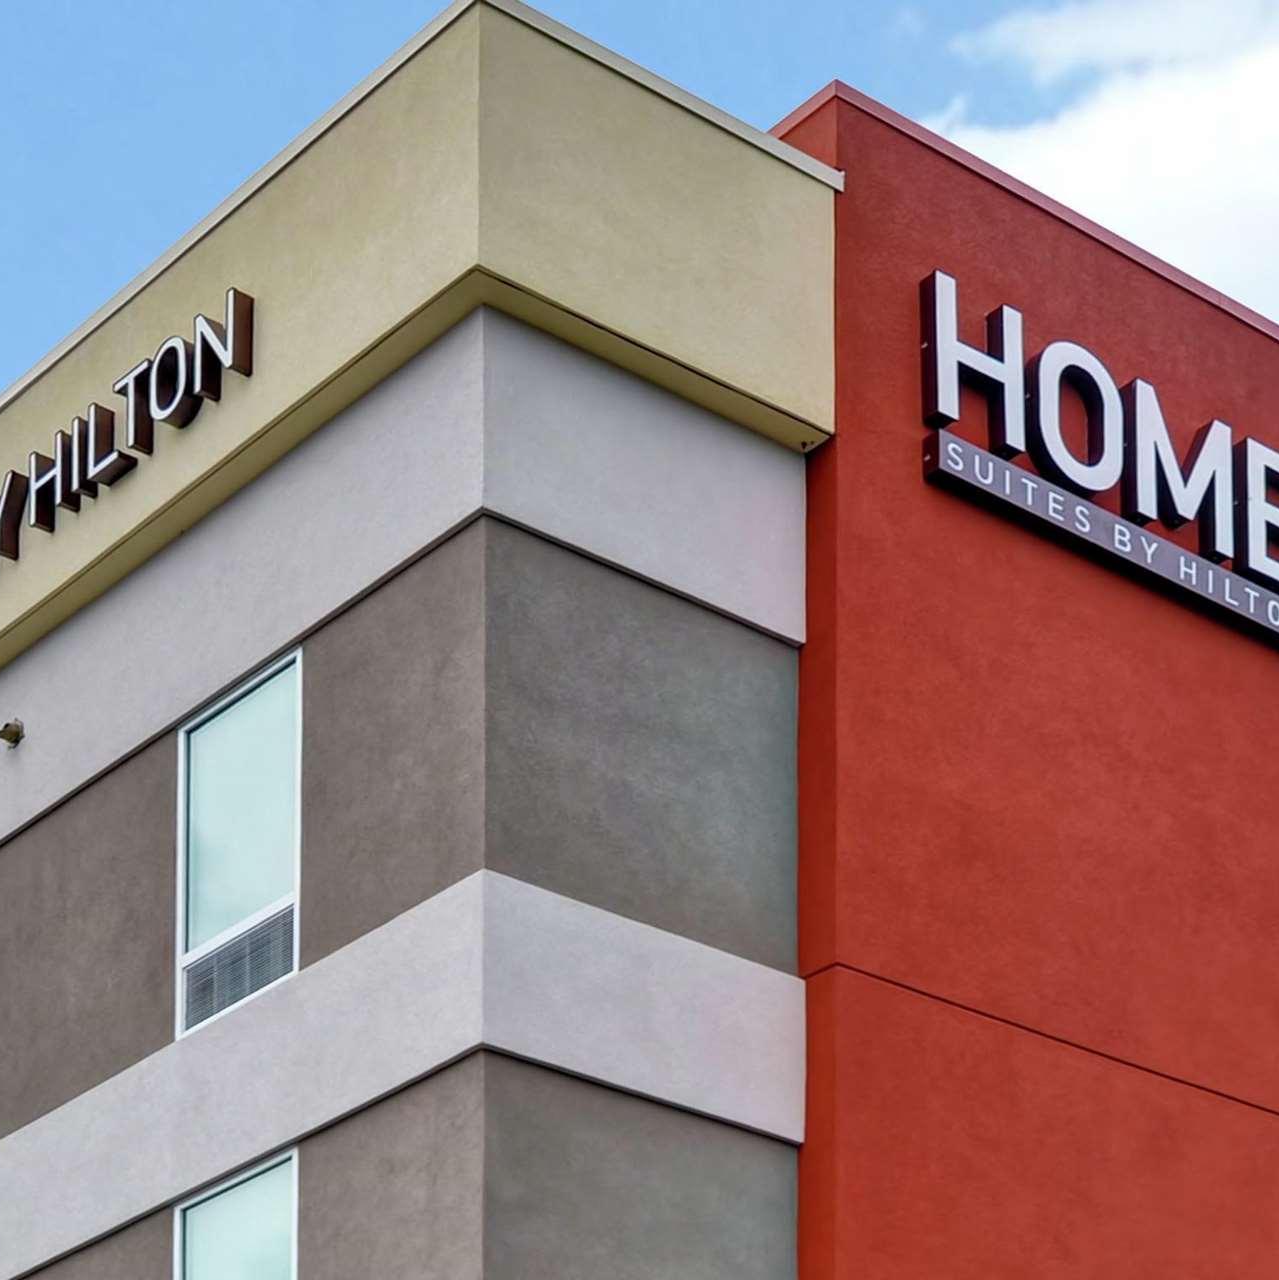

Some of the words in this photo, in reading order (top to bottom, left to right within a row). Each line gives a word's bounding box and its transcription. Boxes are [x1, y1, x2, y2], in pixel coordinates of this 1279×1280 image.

[27, 287, 252, 529] HILTON
[946, 442, 1092, 534] SUITES
[1114, 523, 1160, 565] BY
